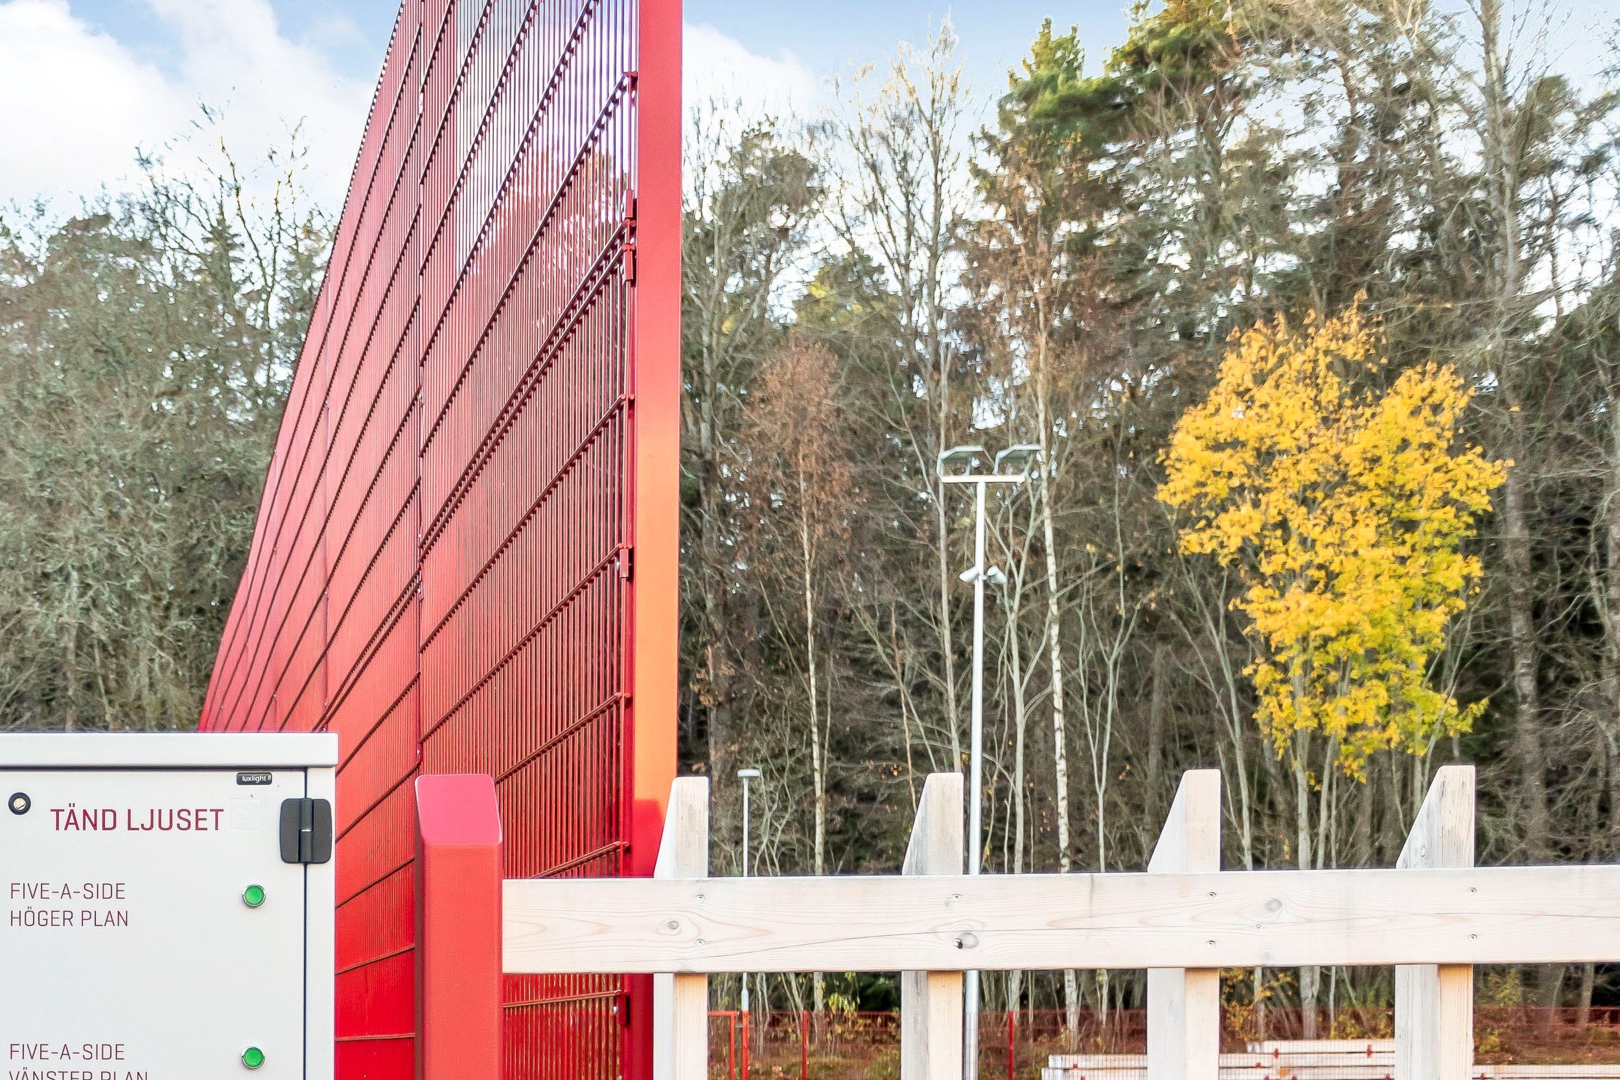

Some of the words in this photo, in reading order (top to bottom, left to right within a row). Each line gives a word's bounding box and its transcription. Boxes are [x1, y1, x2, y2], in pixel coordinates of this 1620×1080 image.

[50, 803, 117, 831] TÄND
[127, 808, 224, 832] LJUSET
[10, 882, 126, 900] FIVE-A-SIDE
[10, 905, 74, 927] HÖGER
[80, 909, 129, 927] PLAN
[9, 1043, 125, 1061] FIVE-A-SIDE
